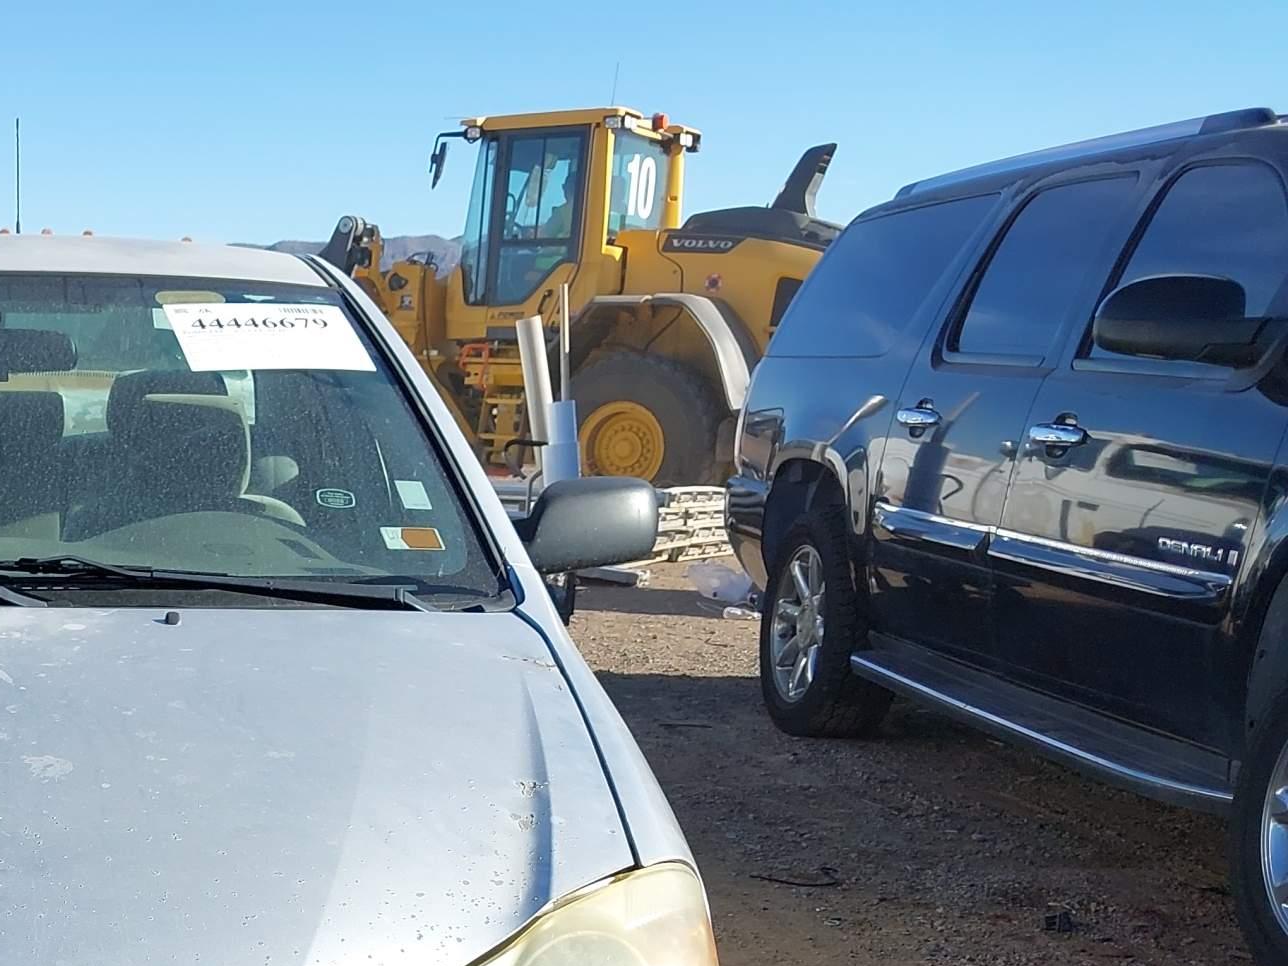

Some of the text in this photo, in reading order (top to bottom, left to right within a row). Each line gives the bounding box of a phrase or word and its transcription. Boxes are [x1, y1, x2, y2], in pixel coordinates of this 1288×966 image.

[627, 153, 656, 219] 10
[672, 239, 732, 248] VOLVO
[191, 317, 328, 330] 44446679
[1158, 537, 1224, 562] DENALI
